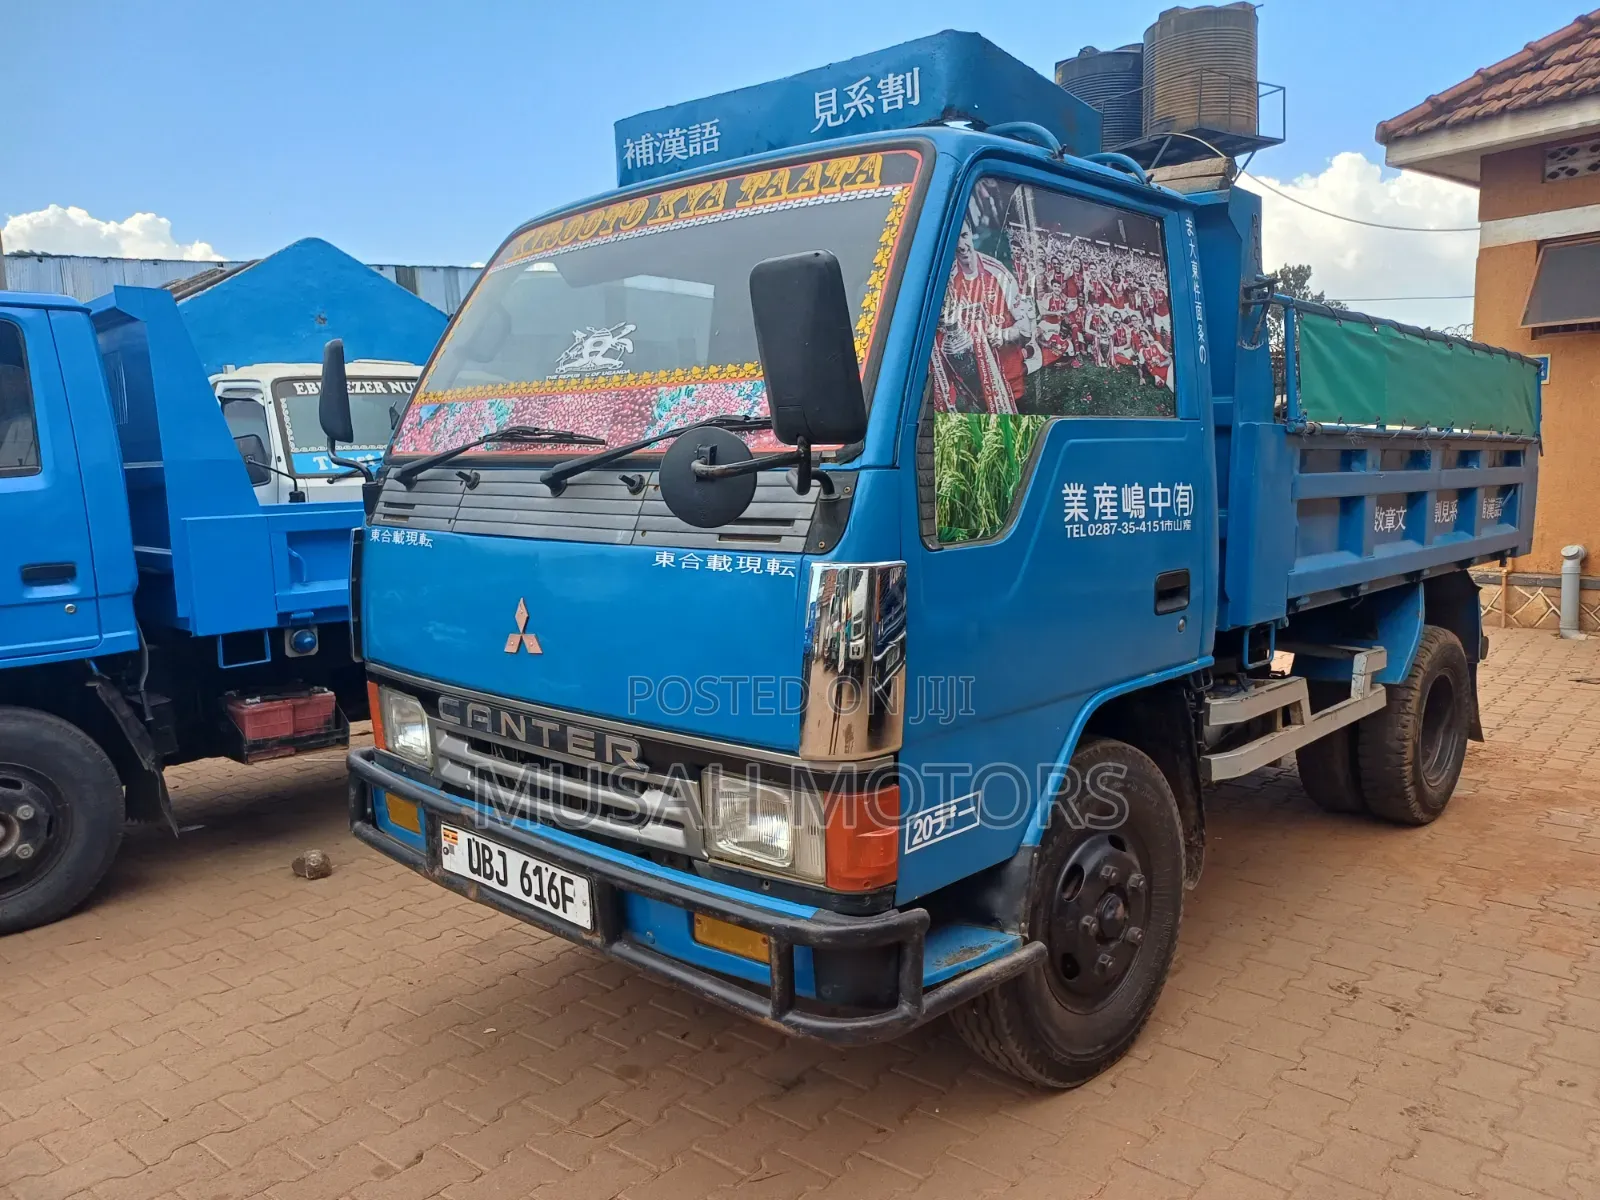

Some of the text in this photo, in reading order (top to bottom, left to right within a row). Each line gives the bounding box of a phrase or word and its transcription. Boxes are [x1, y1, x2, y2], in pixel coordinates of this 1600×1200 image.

[810, 66, 920, 133] 見系割
[622, 118, 721, 170] 補漢語
[648, 180, 728, 226] KYA
[735, 153, 882, 208] TAATA
[652, 550, 796, 578] 東合載現転
[438, 696, 647, 770] CANTER
[467, 837, 575, 914] UBJ 616F
